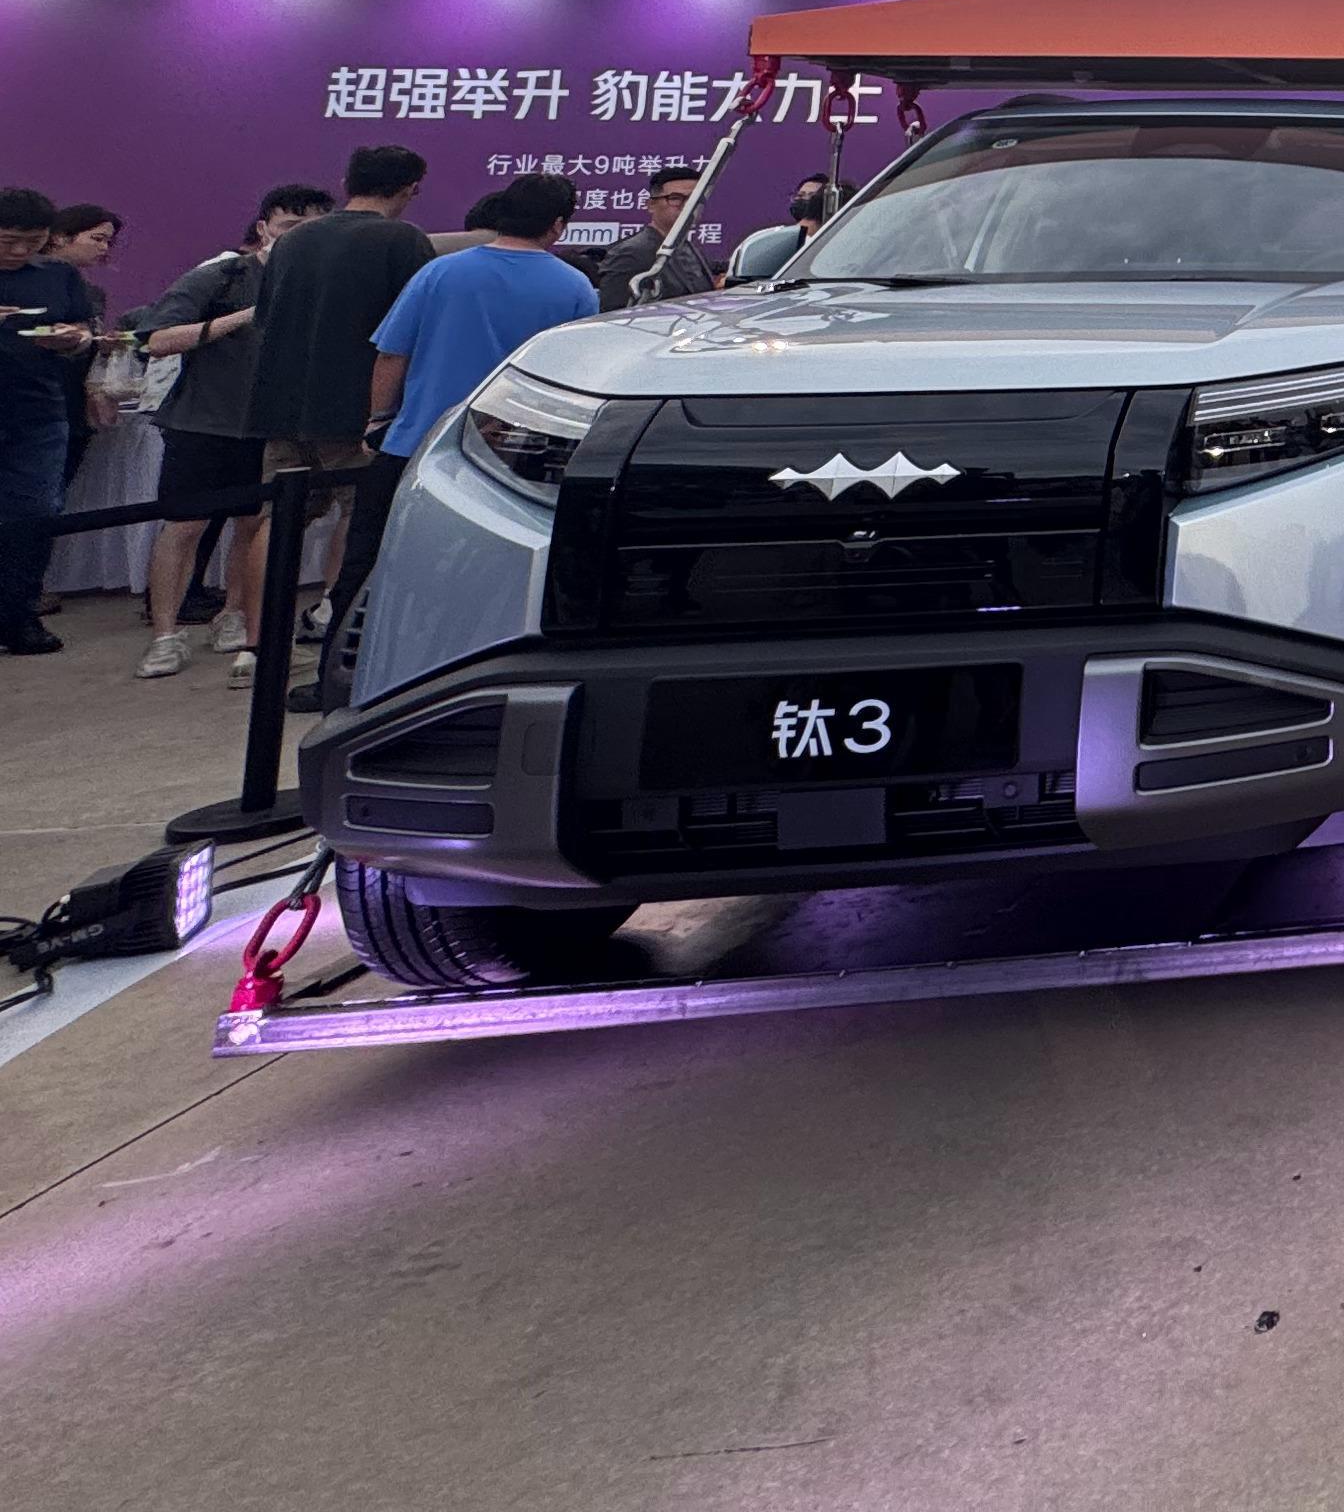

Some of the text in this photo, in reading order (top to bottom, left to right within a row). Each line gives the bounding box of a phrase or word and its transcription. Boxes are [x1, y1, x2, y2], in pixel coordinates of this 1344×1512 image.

[324, 66, 570, 120] 超强举升
[771, 698, 892, 759] 钛3
